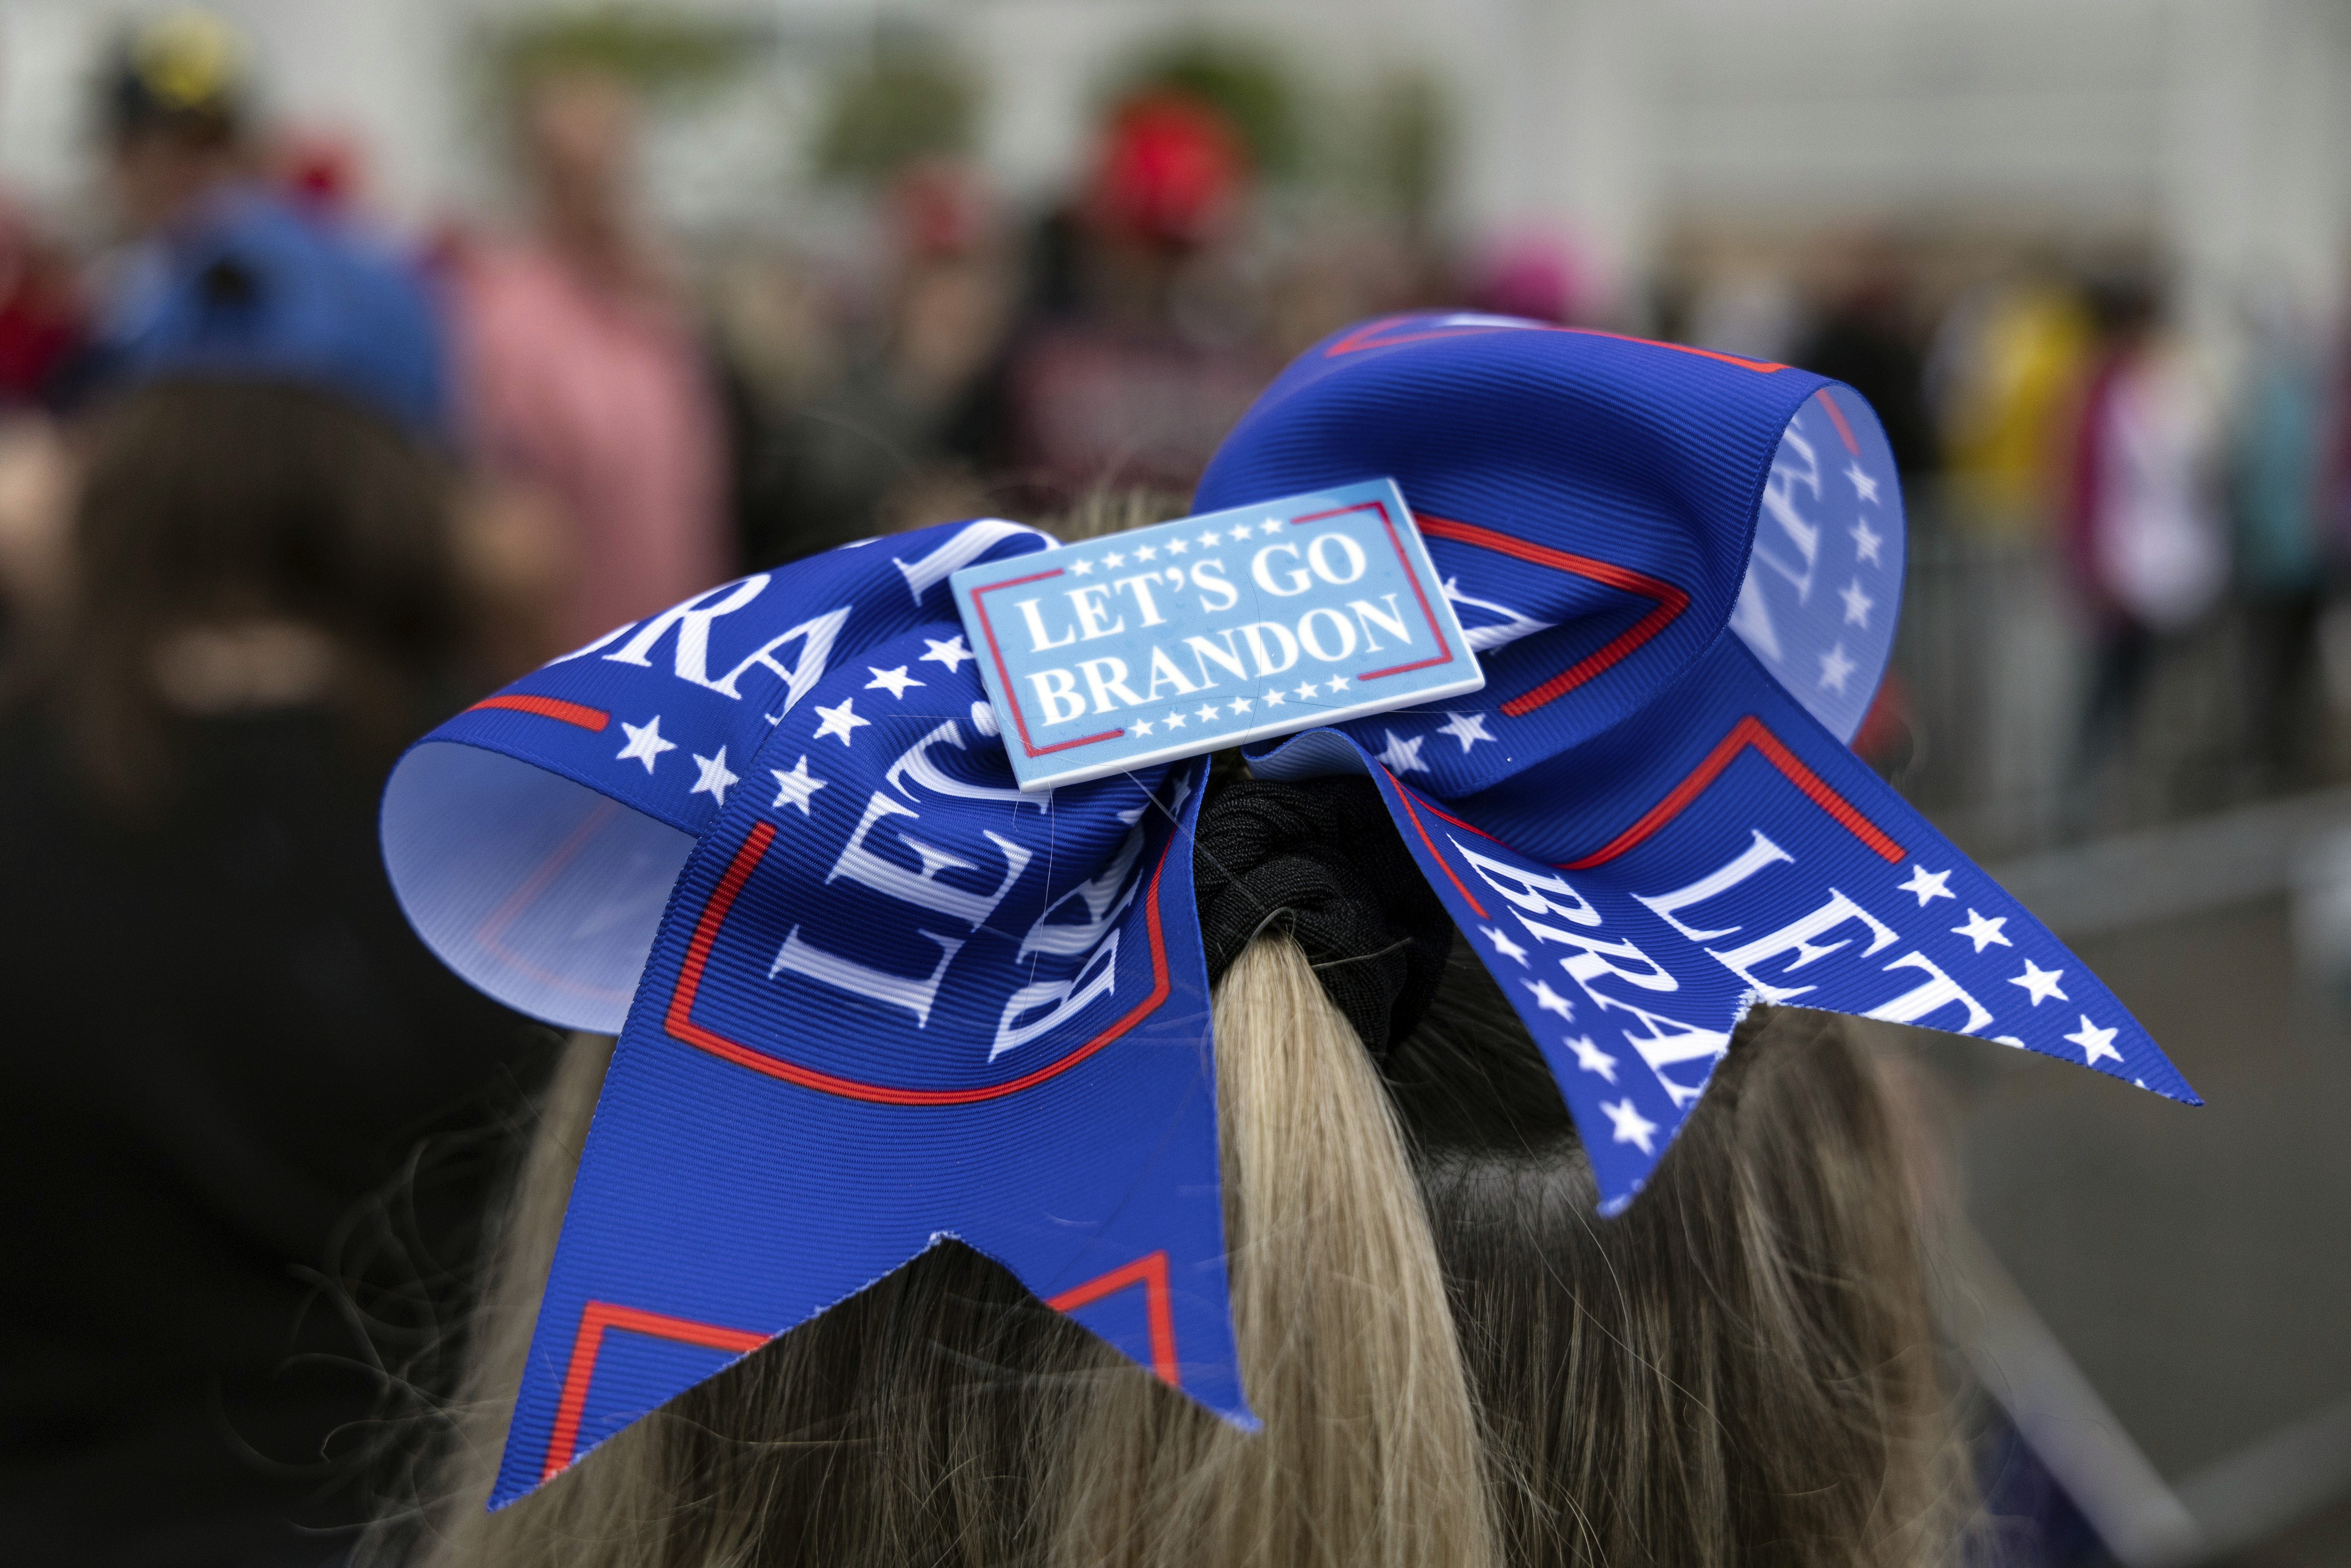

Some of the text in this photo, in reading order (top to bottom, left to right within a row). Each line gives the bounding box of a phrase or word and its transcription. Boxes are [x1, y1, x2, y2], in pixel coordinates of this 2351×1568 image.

[544, 572, 853, 726] RA
[1014, 556, 1239, 654] LET'S
[1251, 532, 1367, 597] GO
[1024, 592, 1413, 728] BRANDON
